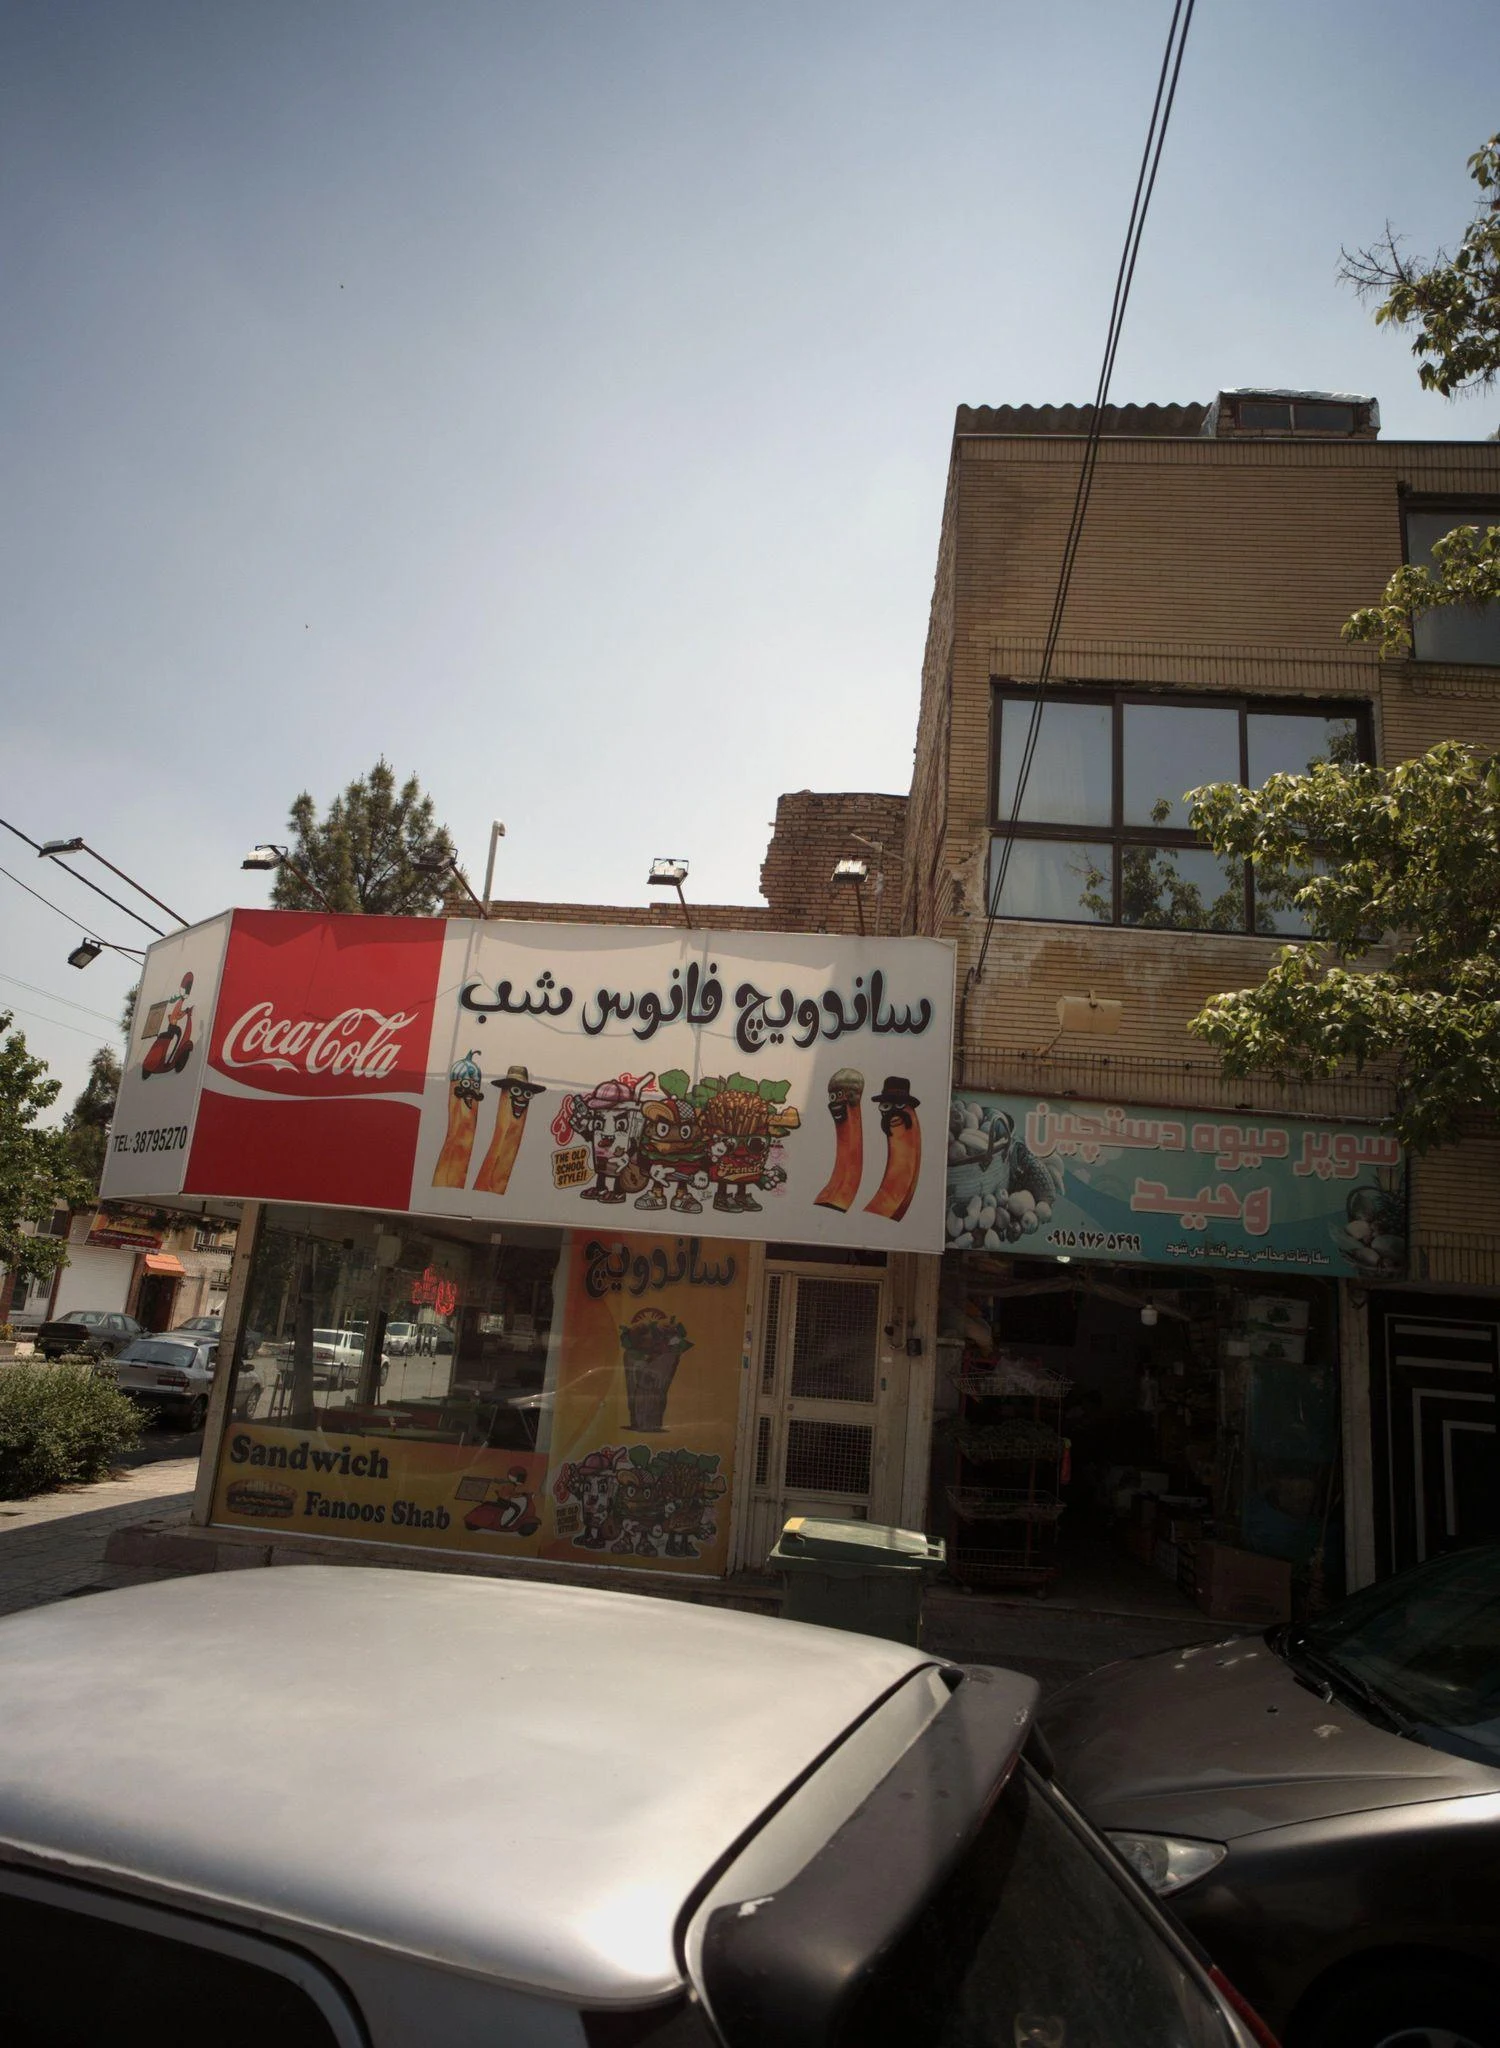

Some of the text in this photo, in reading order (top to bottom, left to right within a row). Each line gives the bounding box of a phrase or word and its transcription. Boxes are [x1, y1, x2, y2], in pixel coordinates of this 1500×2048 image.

[460, 962, 932, 1053] ساندویچ فانوس شب
[221, 1001, 418, 1080] Coca-Cola
[114, 1127, 188, 1154] TEL: 38795270
[555, 1149, 587, 1164] THE OLD
[1026, 1102, 1401, 1180] سوپر میوه دستچین
[556, 1160, 585, 1175] SCHOOL
[1130, 1177, 1272, 1236] وحید
[584, 1237, 736, 1299] ساندویچ
[229, 1434, 389, 1480] Sandwich
[304, 1490, 451, 1531] Fanoos Shab
